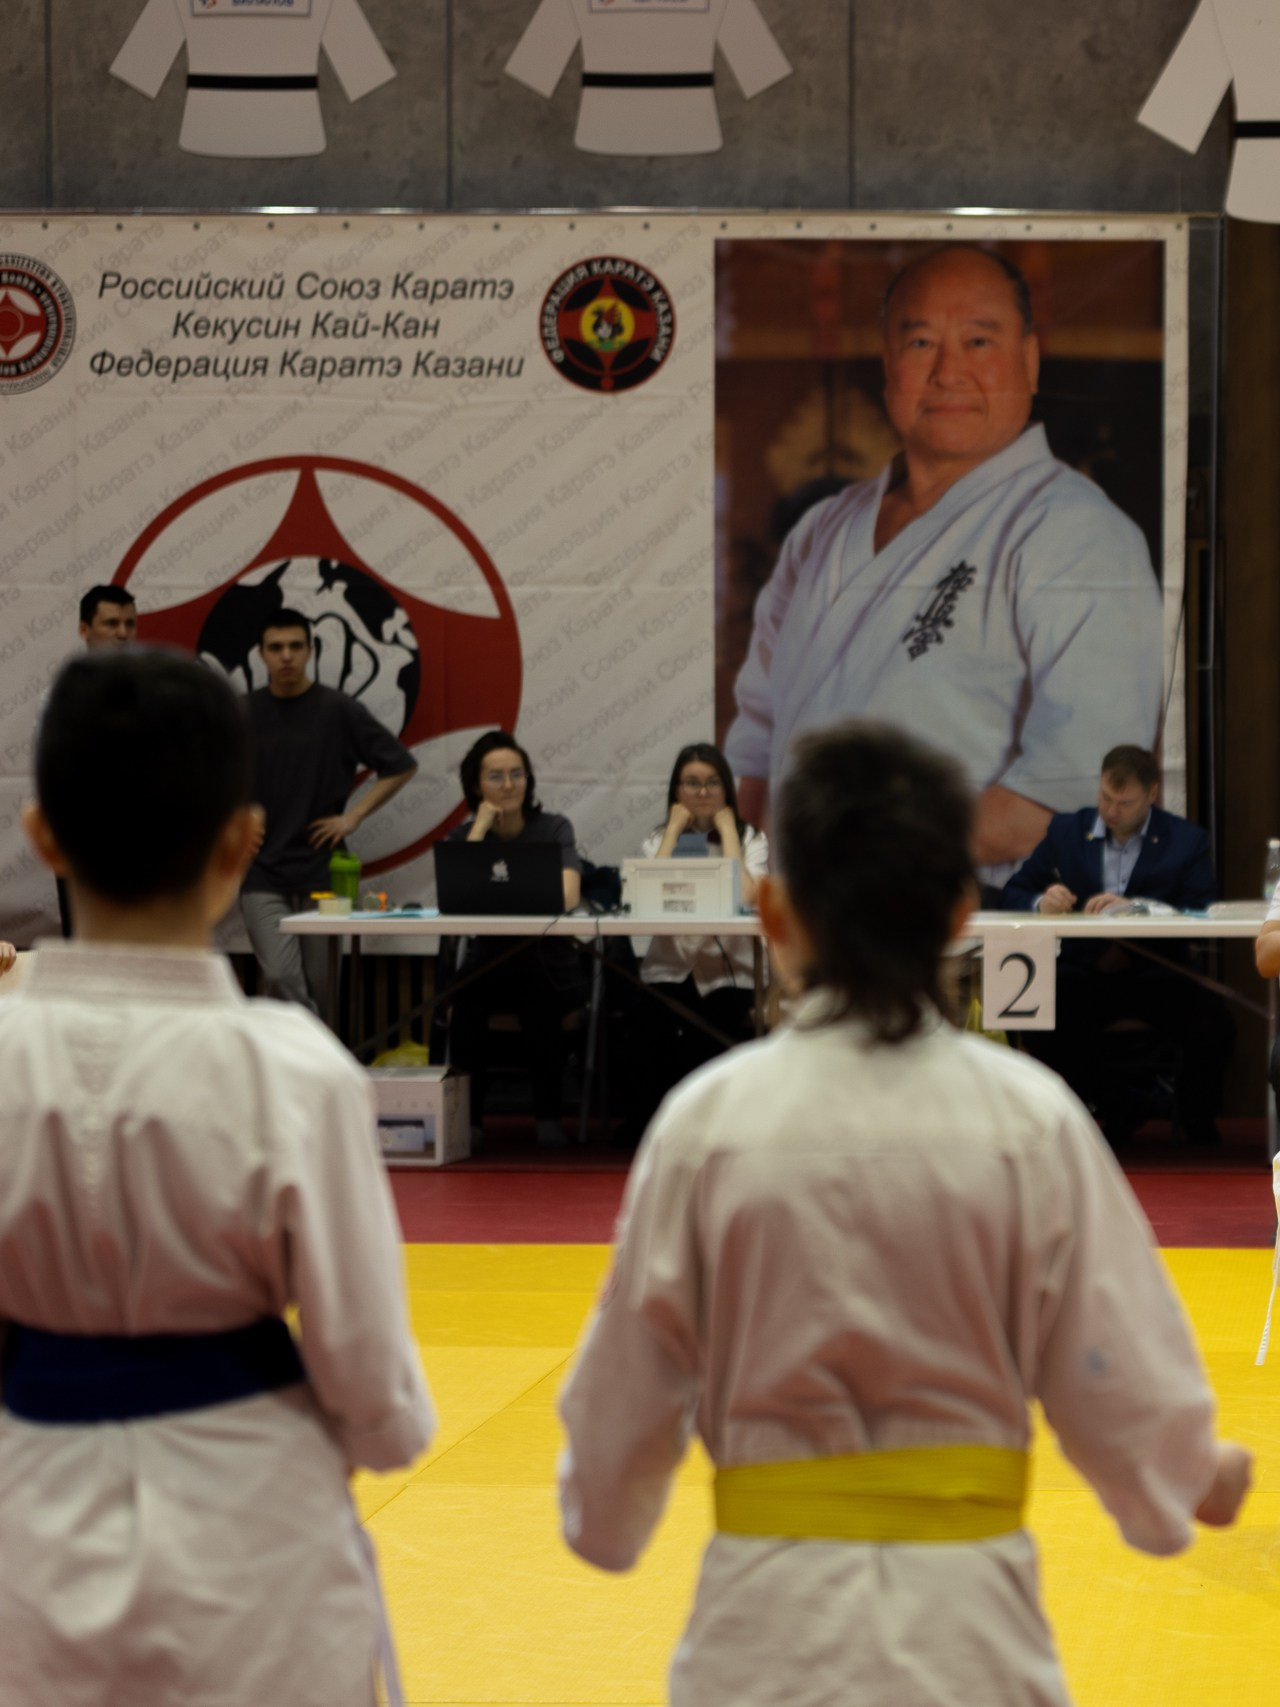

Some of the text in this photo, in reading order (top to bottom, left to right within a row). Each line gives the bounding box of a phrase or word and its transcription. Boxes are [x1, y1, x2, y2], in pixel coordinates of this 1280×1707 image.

[98, 271, 285, 300] Российский
[297, 271, 381, 300] Союз
[392, 272, 514, 305] Каратэ
[172, 310, 301, 345] Кекусин
[312, 311, 440, 338] Кай-Кан
[542, 262, 589, 363] ФЕДЕРАЦИЯ
[590, 259, 655, 292] КАРАТЭ
[649, 289, 673, 363] КАЗАНИ
[89, 349, 269, 384] Федерация
[280, 350, 402, 384] Каратэ
[412, 350, 524, 377] Казани
[998, 952, 1040, 1018] 2
